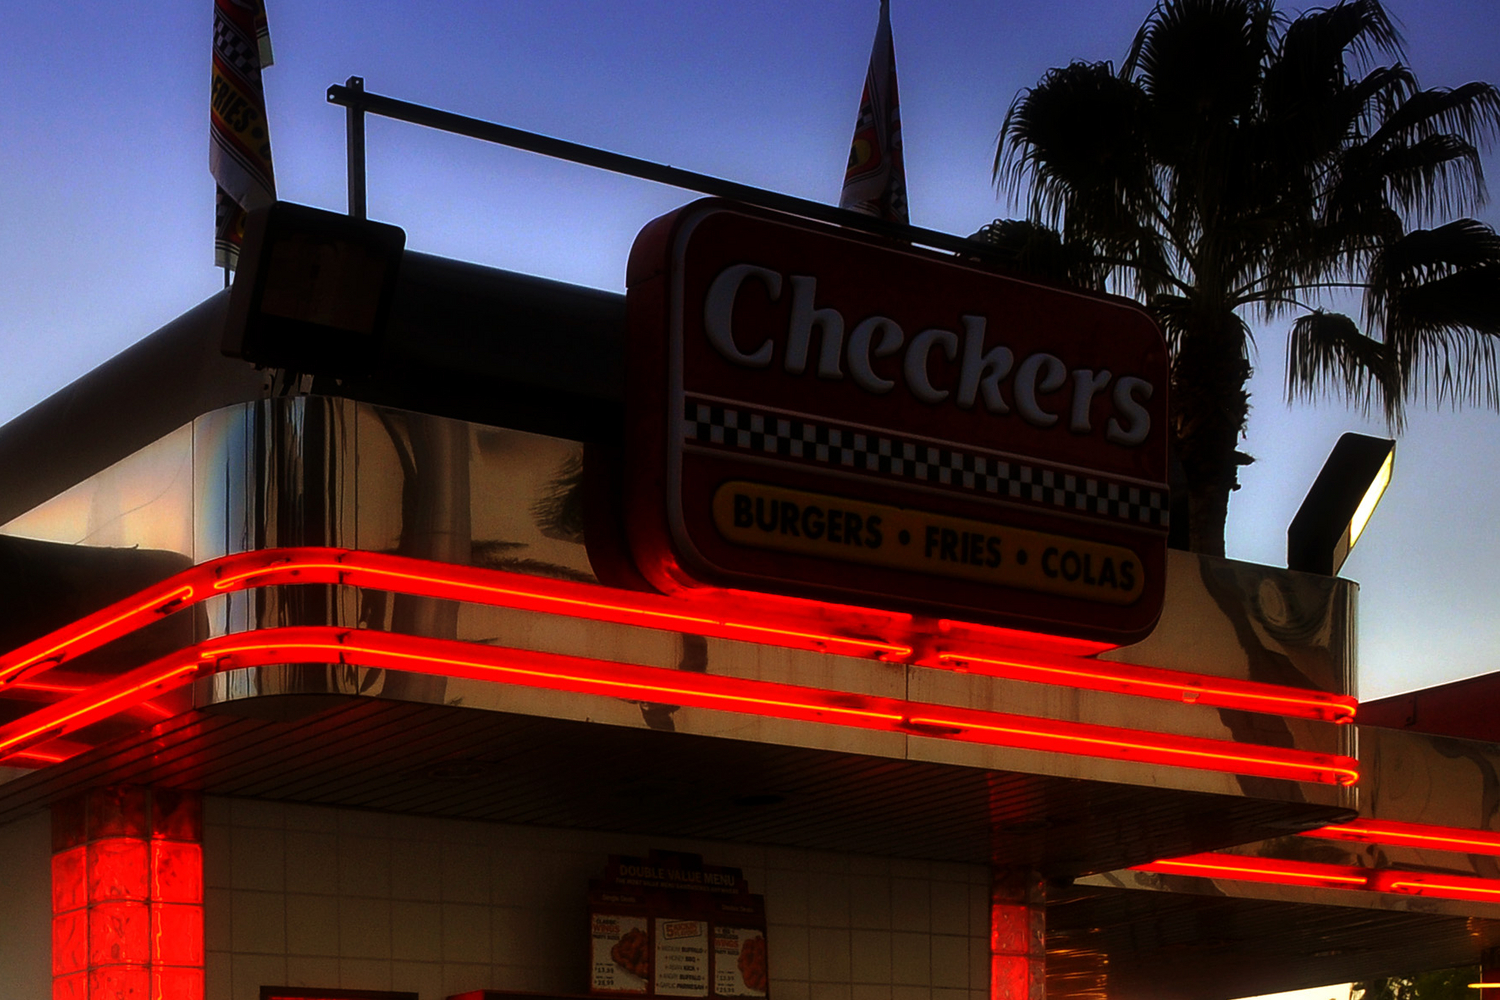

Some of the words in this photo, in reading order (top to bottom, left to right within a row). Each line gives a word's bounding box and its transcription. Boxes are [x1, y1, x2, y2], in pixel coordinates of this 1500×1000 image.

[212, 74, 258, 133] FRIES
[703, 263, 1154, 446] Checkers
[733, 493, 883, 548] BURGERS
[924, 526, 1002, 568] FRIES
[1041, 547, 1136, 591] COLAS
[620, 864, 665, 880] DOUBLE
[667, 869, 702, 883] VALUE
[704, 873, 735, 887] MENU
[593, 924, 620, 933] WINGS
